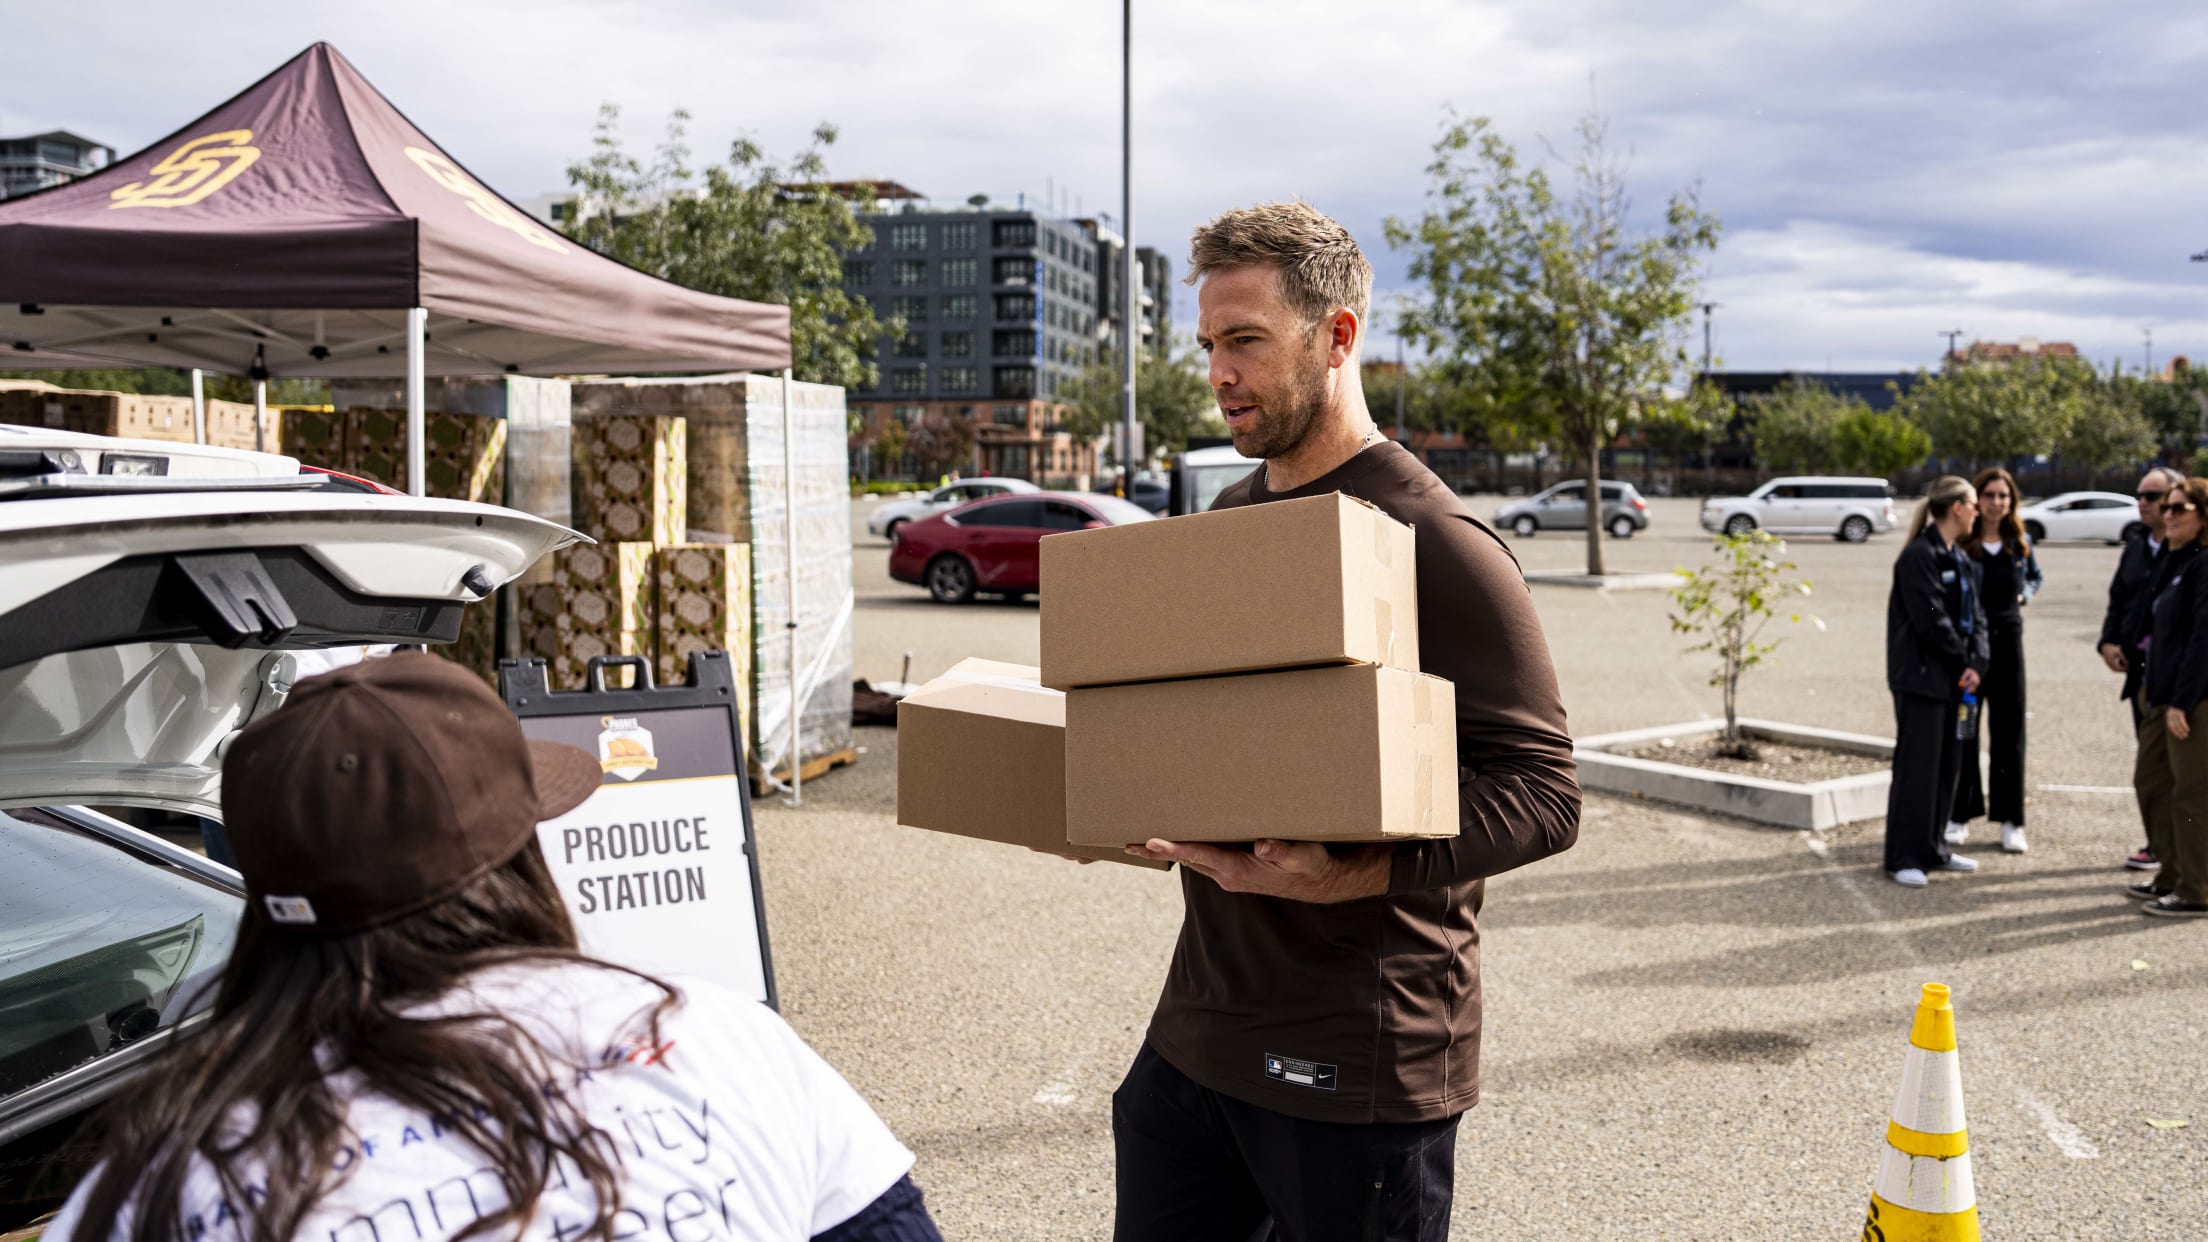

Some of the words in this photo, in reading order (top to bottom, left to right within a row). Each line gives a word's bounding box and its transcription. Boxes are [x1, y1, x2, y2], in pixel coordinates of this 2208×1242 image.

[108, 129, 262, 209] SD
[563, 817, 710, 864] PRODUCE
[577, 866, 707, 914] STATION
